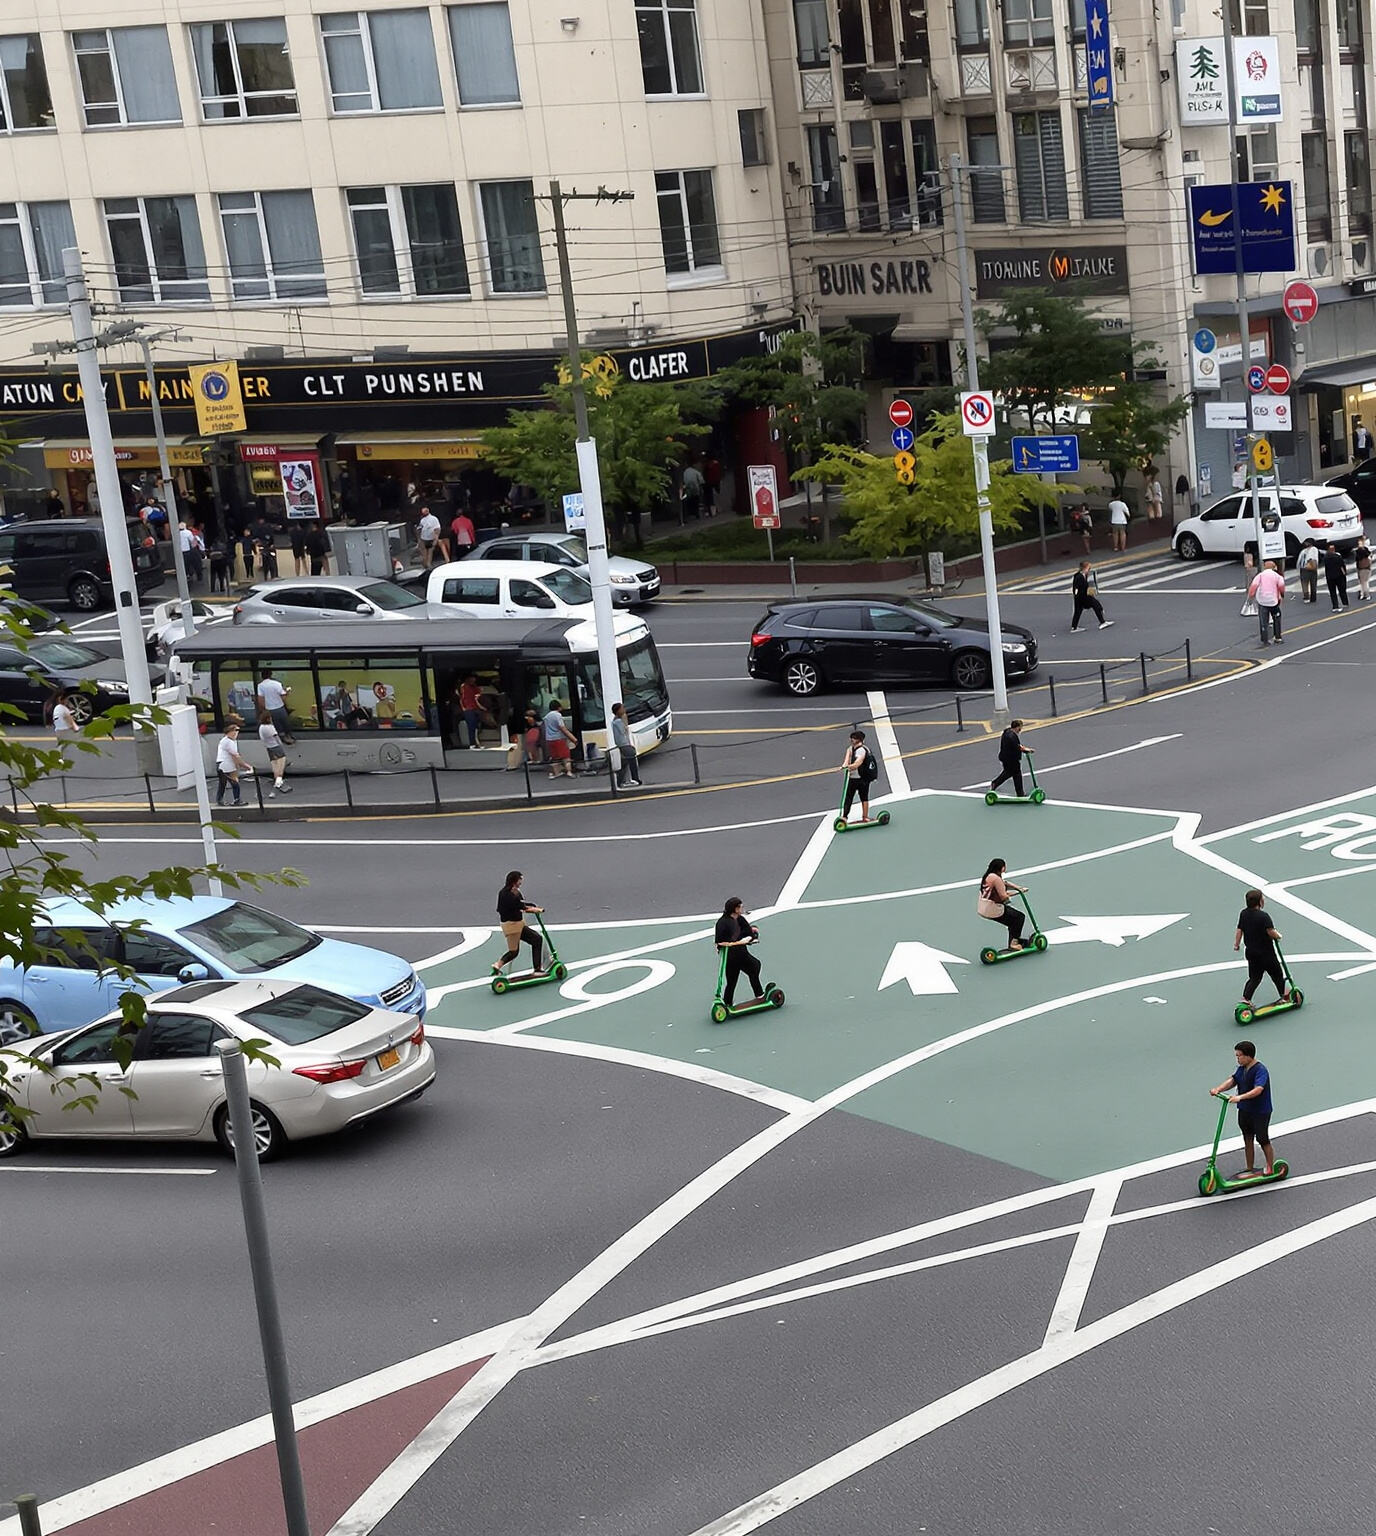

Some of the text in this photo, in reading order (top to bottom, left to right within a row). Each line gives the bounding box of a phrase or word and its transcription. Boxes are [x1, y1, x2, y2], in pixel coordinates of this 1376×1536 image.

[817, 263, 866, 296] BUIN
[629, 351, 689, 381] CLAFER
[303, 371, 484, 396] CLT PUNSHEN
